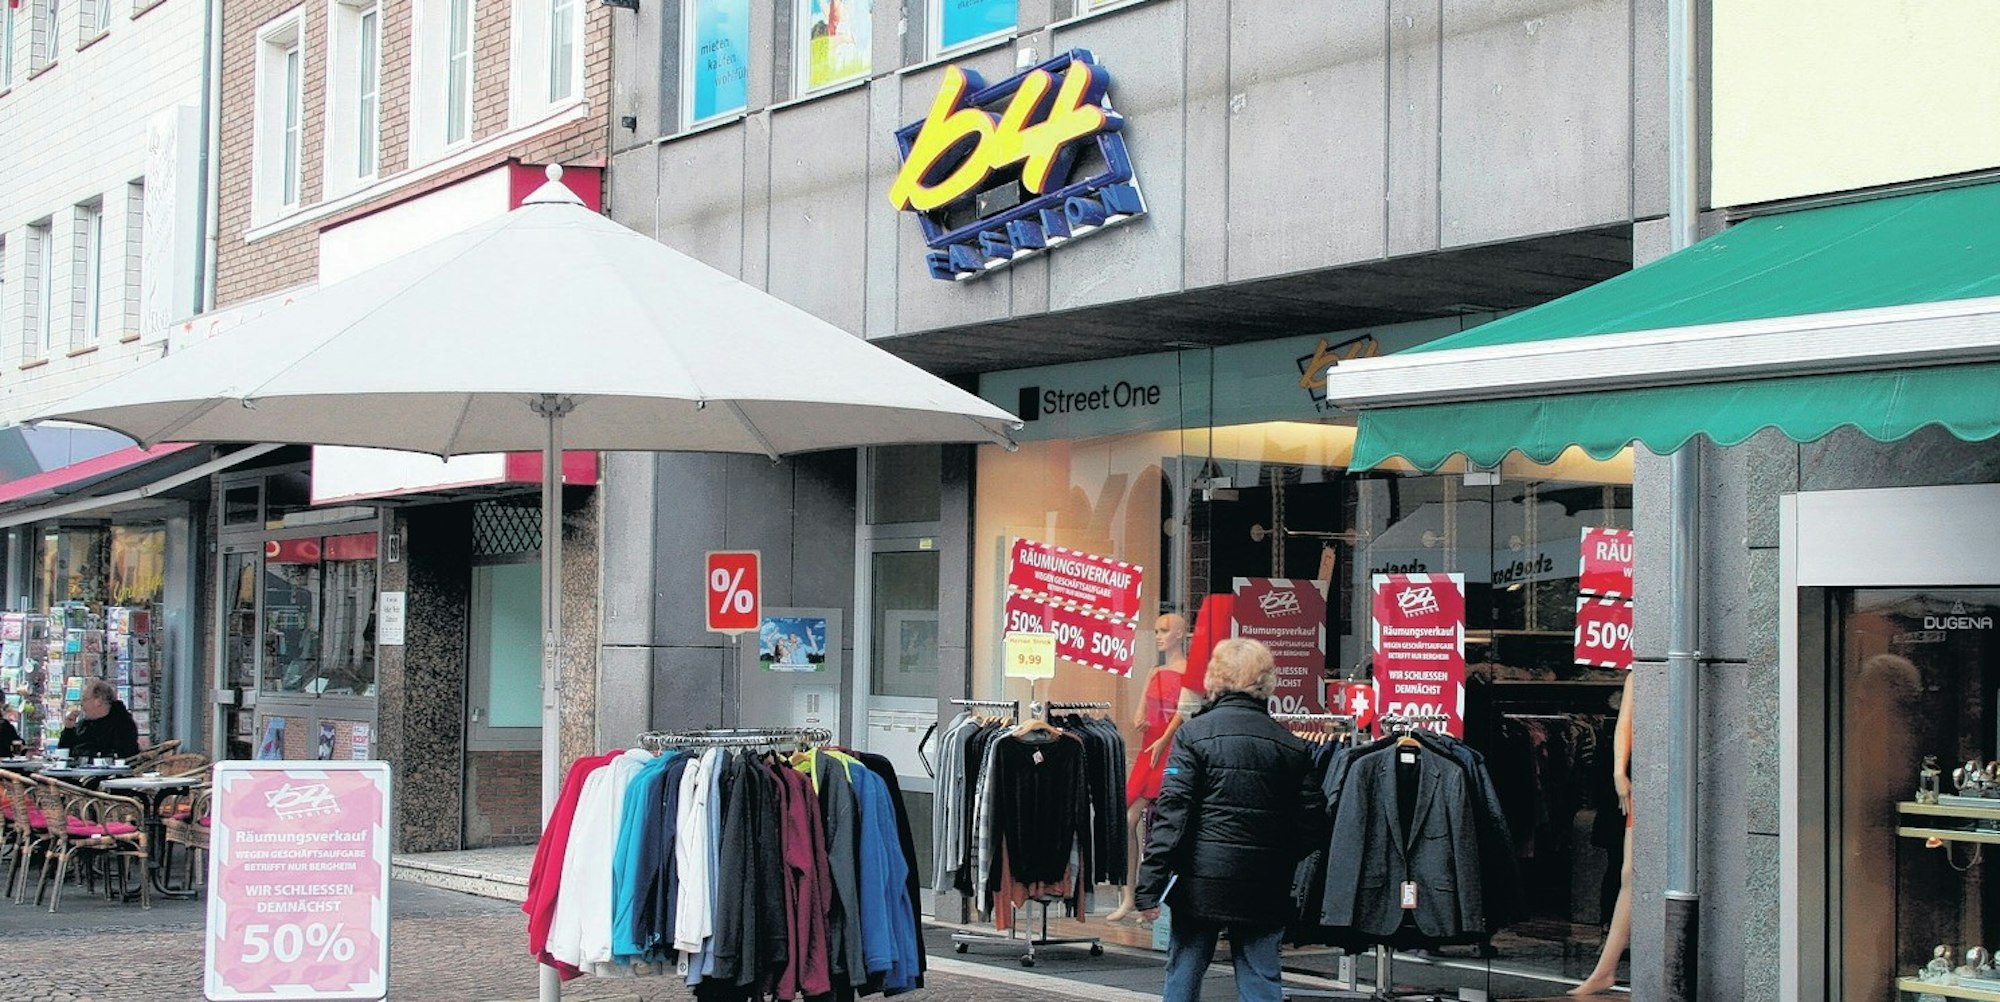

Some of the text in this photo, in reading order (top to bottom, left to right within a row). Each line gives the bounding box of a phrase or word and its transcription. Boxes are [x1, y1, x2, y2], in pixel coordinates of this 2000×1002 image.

[888, 63, 1107, 213] b4
[926, 183, 1143, 282] FASHION
[1043, 381, 1161, 414] Street One
[1019, 547, 1132, 589] RÄUMUNGSVERKAUF
[1923, 616, 1993, 630] DUGENA
[1010, 609, 1128, 661] 50% 50% 50%
[1242, 625, 1316, 638] Räumungsverkauf
[1382, 625, 1454, 639] Räumungsverkauf
[1585, 620, 1633, 651] 50%
[1389, 670, 1448, 681] WIR SCHLIESSEN
[1276, 678, 1302, 688] ÄCHST
[1394, 683, 1442, 695] DEMNÄCHST
[235, 830, 368, 845] Räumungsverkauf
[235, 848, 366, 860] WEGEN GESCHÄFTSAUFGABE
[244, 862, 357, 872] BETRIFFT NUR BERGHEIM
[245, 884, 354, 896] WIR SCHLIESSEN
[257, 900, 342, 913] DEMNÄCHST
[241, 922, 356, 963] 50%
